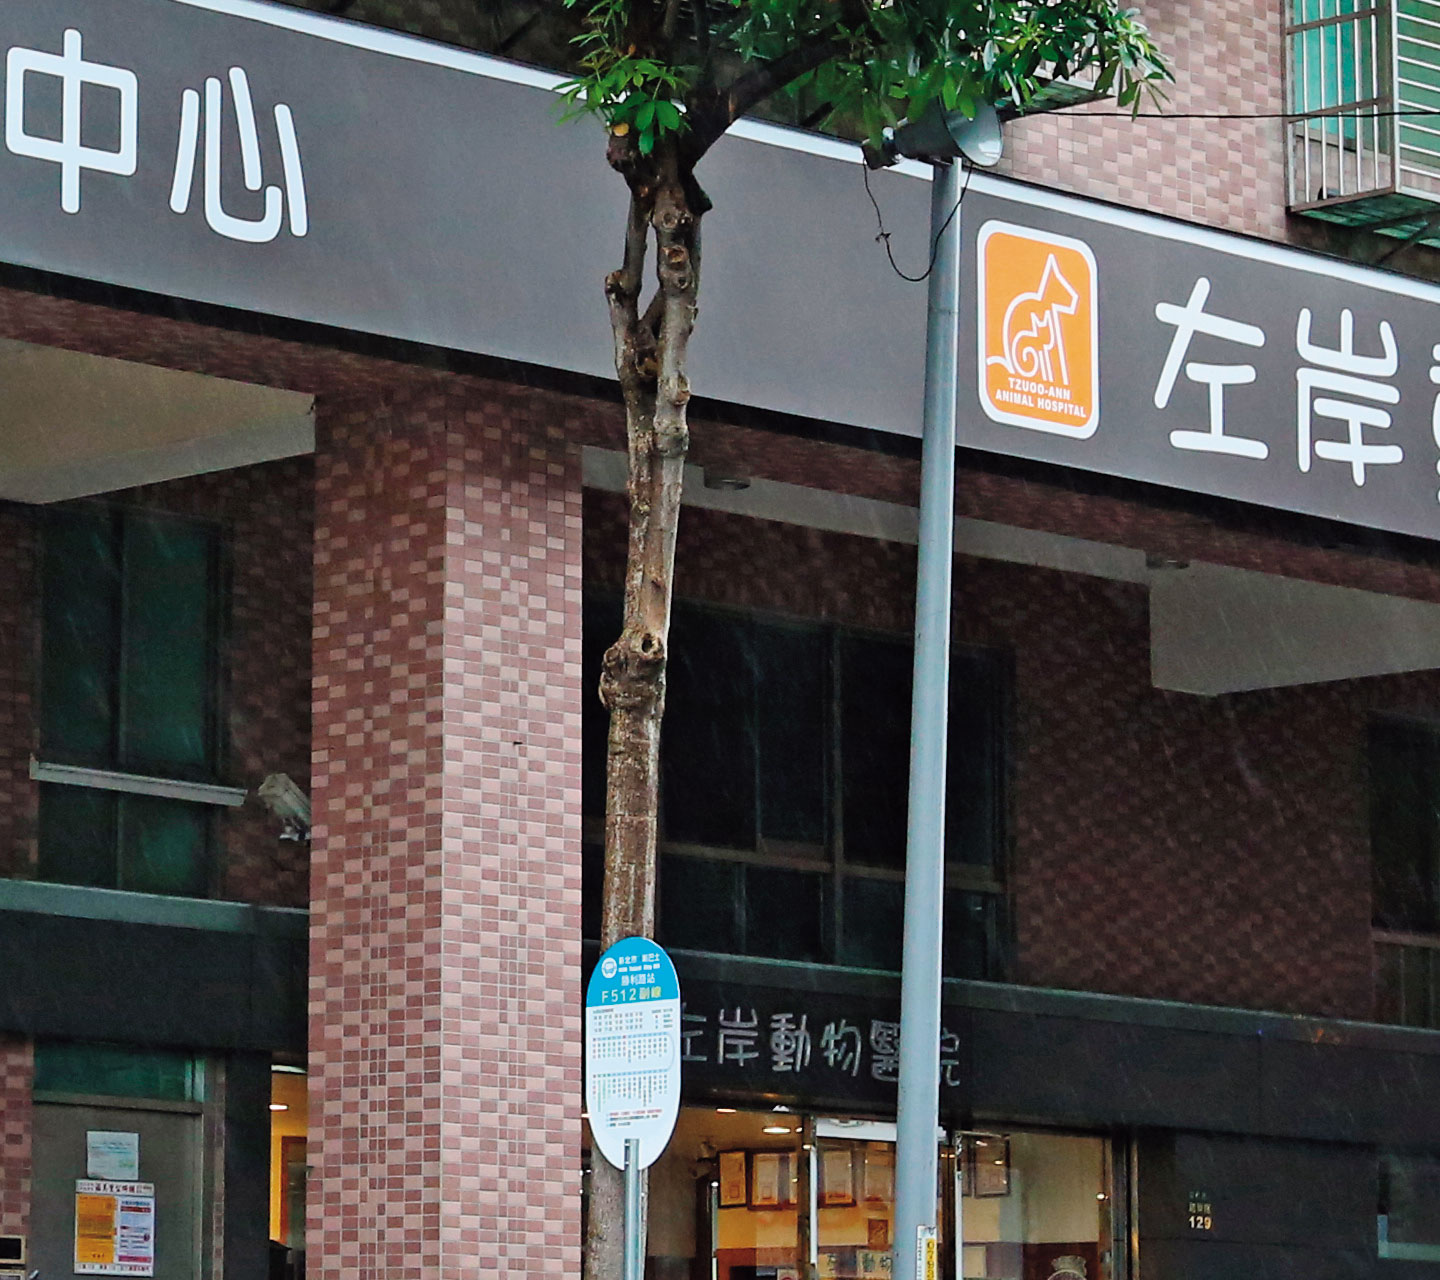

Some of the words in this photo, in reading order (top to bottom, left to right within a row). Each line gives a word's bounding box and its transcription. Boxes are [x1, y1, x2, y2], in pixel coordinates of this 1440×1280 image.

[1007, 377, 1071, 401] TZUOO-ANN
[995, 389, 1034, 408] ANIMAL
[1037, 397, 1087, 418] HOSPITAL
[1189, 1215, 1212, 1230] 129
